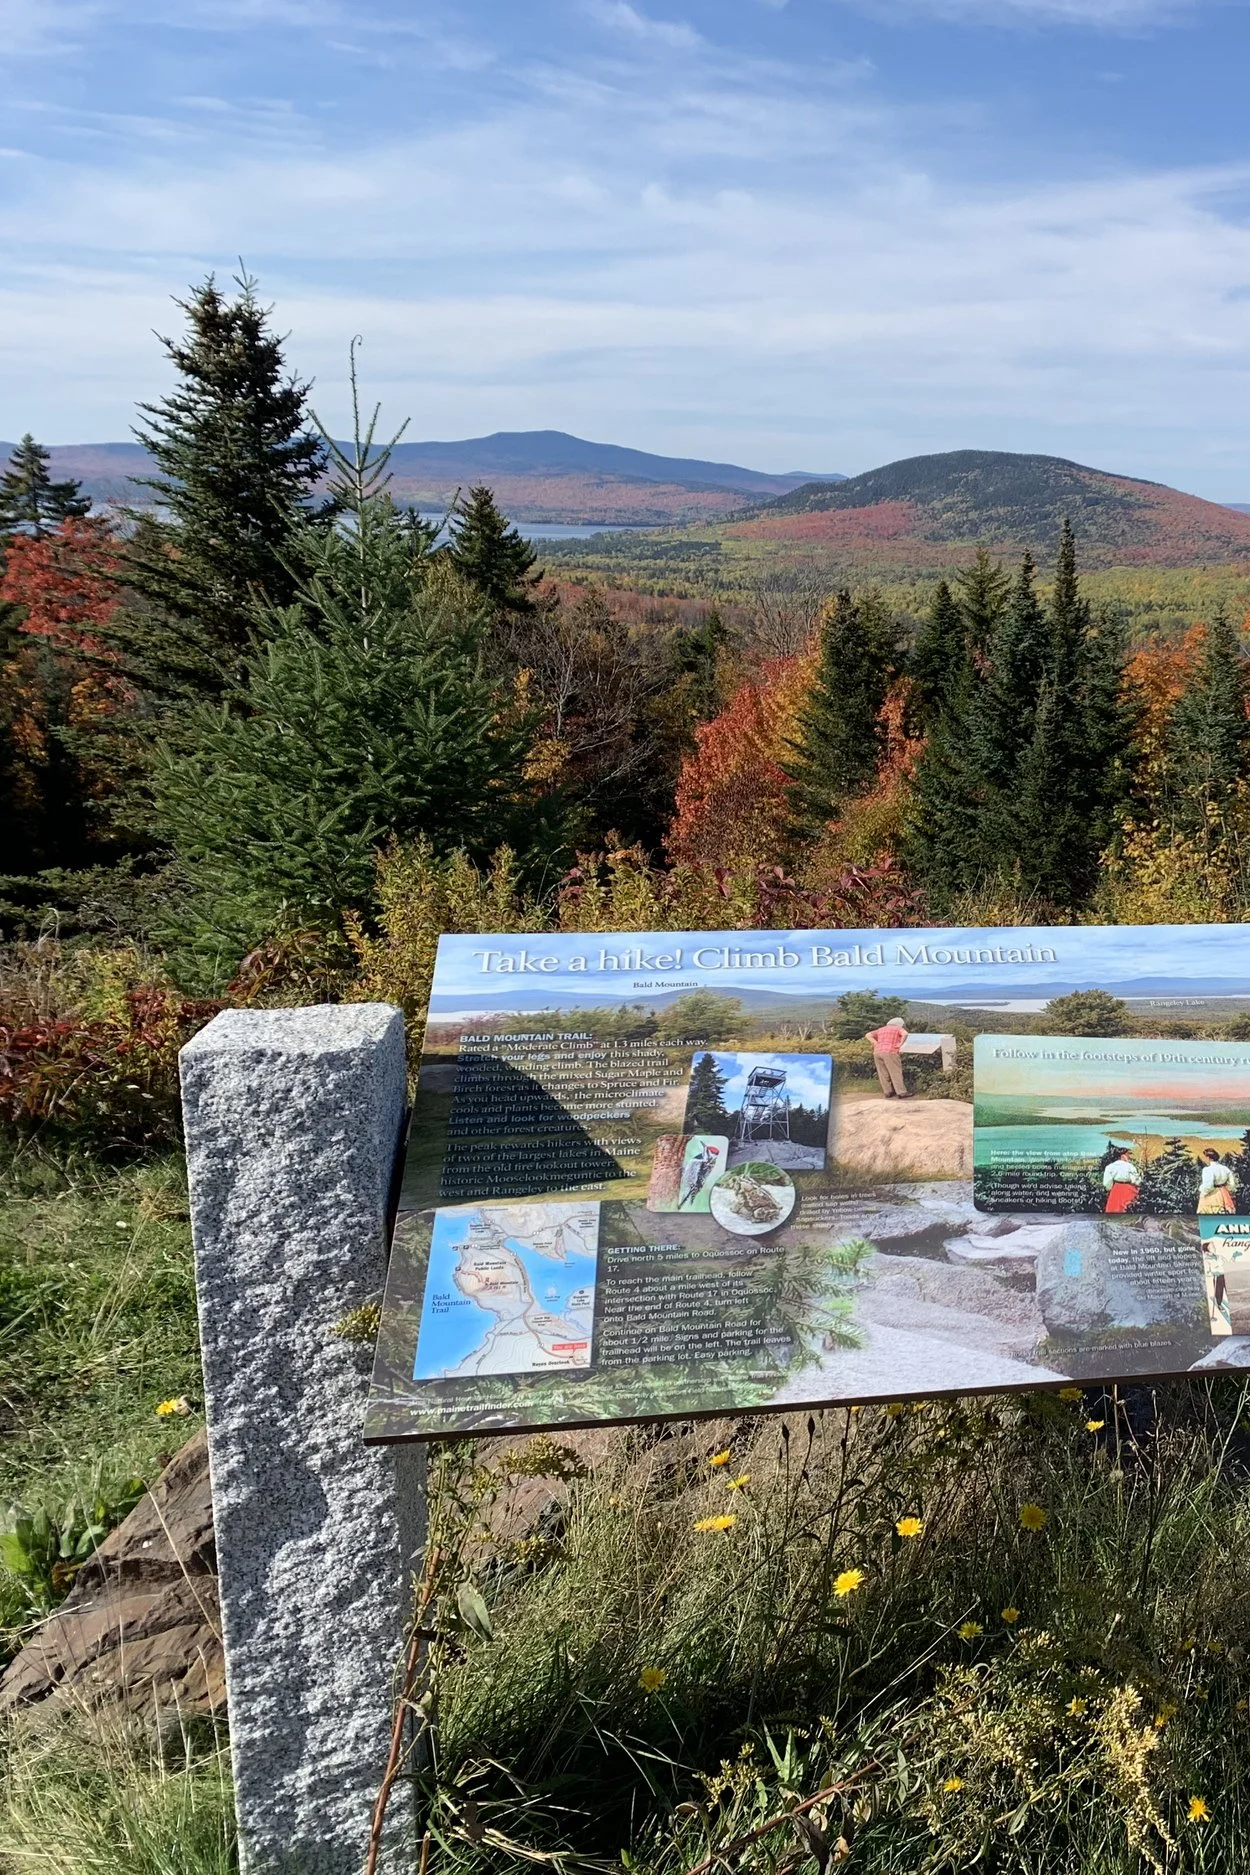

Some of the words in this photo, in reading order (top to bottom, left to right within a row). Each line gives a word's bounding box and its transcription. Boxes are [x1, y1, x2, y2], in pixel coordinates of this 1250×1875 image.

[472, 950, 559, 972] Take
[569, 956, 586, 971] a
[600, 950, 682, 970] hike!
[692, 946, 799, 970] Climb
[810, 945, 884, 967] Bald
[896, 943, 1057, 965] Mountain
[685, 1040, 708, 1048] way.
[993, 1049, 1038, 1059] Follow
[1041, 1050, 1054, 1059] in
[1056, 1050, 1078, 1059] the
[1080, 1051, 1139, 1063] footsteps
[1142, 1052, 1157, 1062] of
[1160, 1053, 1186, 1063] 19th
[1188, 1056, 1238, 1066] century
[506, 1063, 549, 1071] winding
[552, 1062, 584, 1070] climb.
[493, 1074, 536, 1082] through
[628, 1069, 660, 1078] Maple
[486, 1084, 514, 1092] forest
[542, 1082, 584, 1091] changes
[601, 1081, 637, 1089] Spruce
[505, 1104, 537, 1113] plants
[541, 1103, 582, 1111] become
[558, 1112, 630, 1121] woodpeckers
[448, 1127, 468, 1135] and
[504, 1125, 534, 1133] forest
[470, 1143, 496, 1152] peak
[500, 1141, 544, 1149] rewards
[519, 1151, 555, 1160] largest
[649, 1244, 680, 1252] THERE:
[648, 1311, 689, 1319] Mountain
[682, 1322, 721, 1331] Mountain
[410, 1402, 533, 1416] www.mainetrailfinder.com
